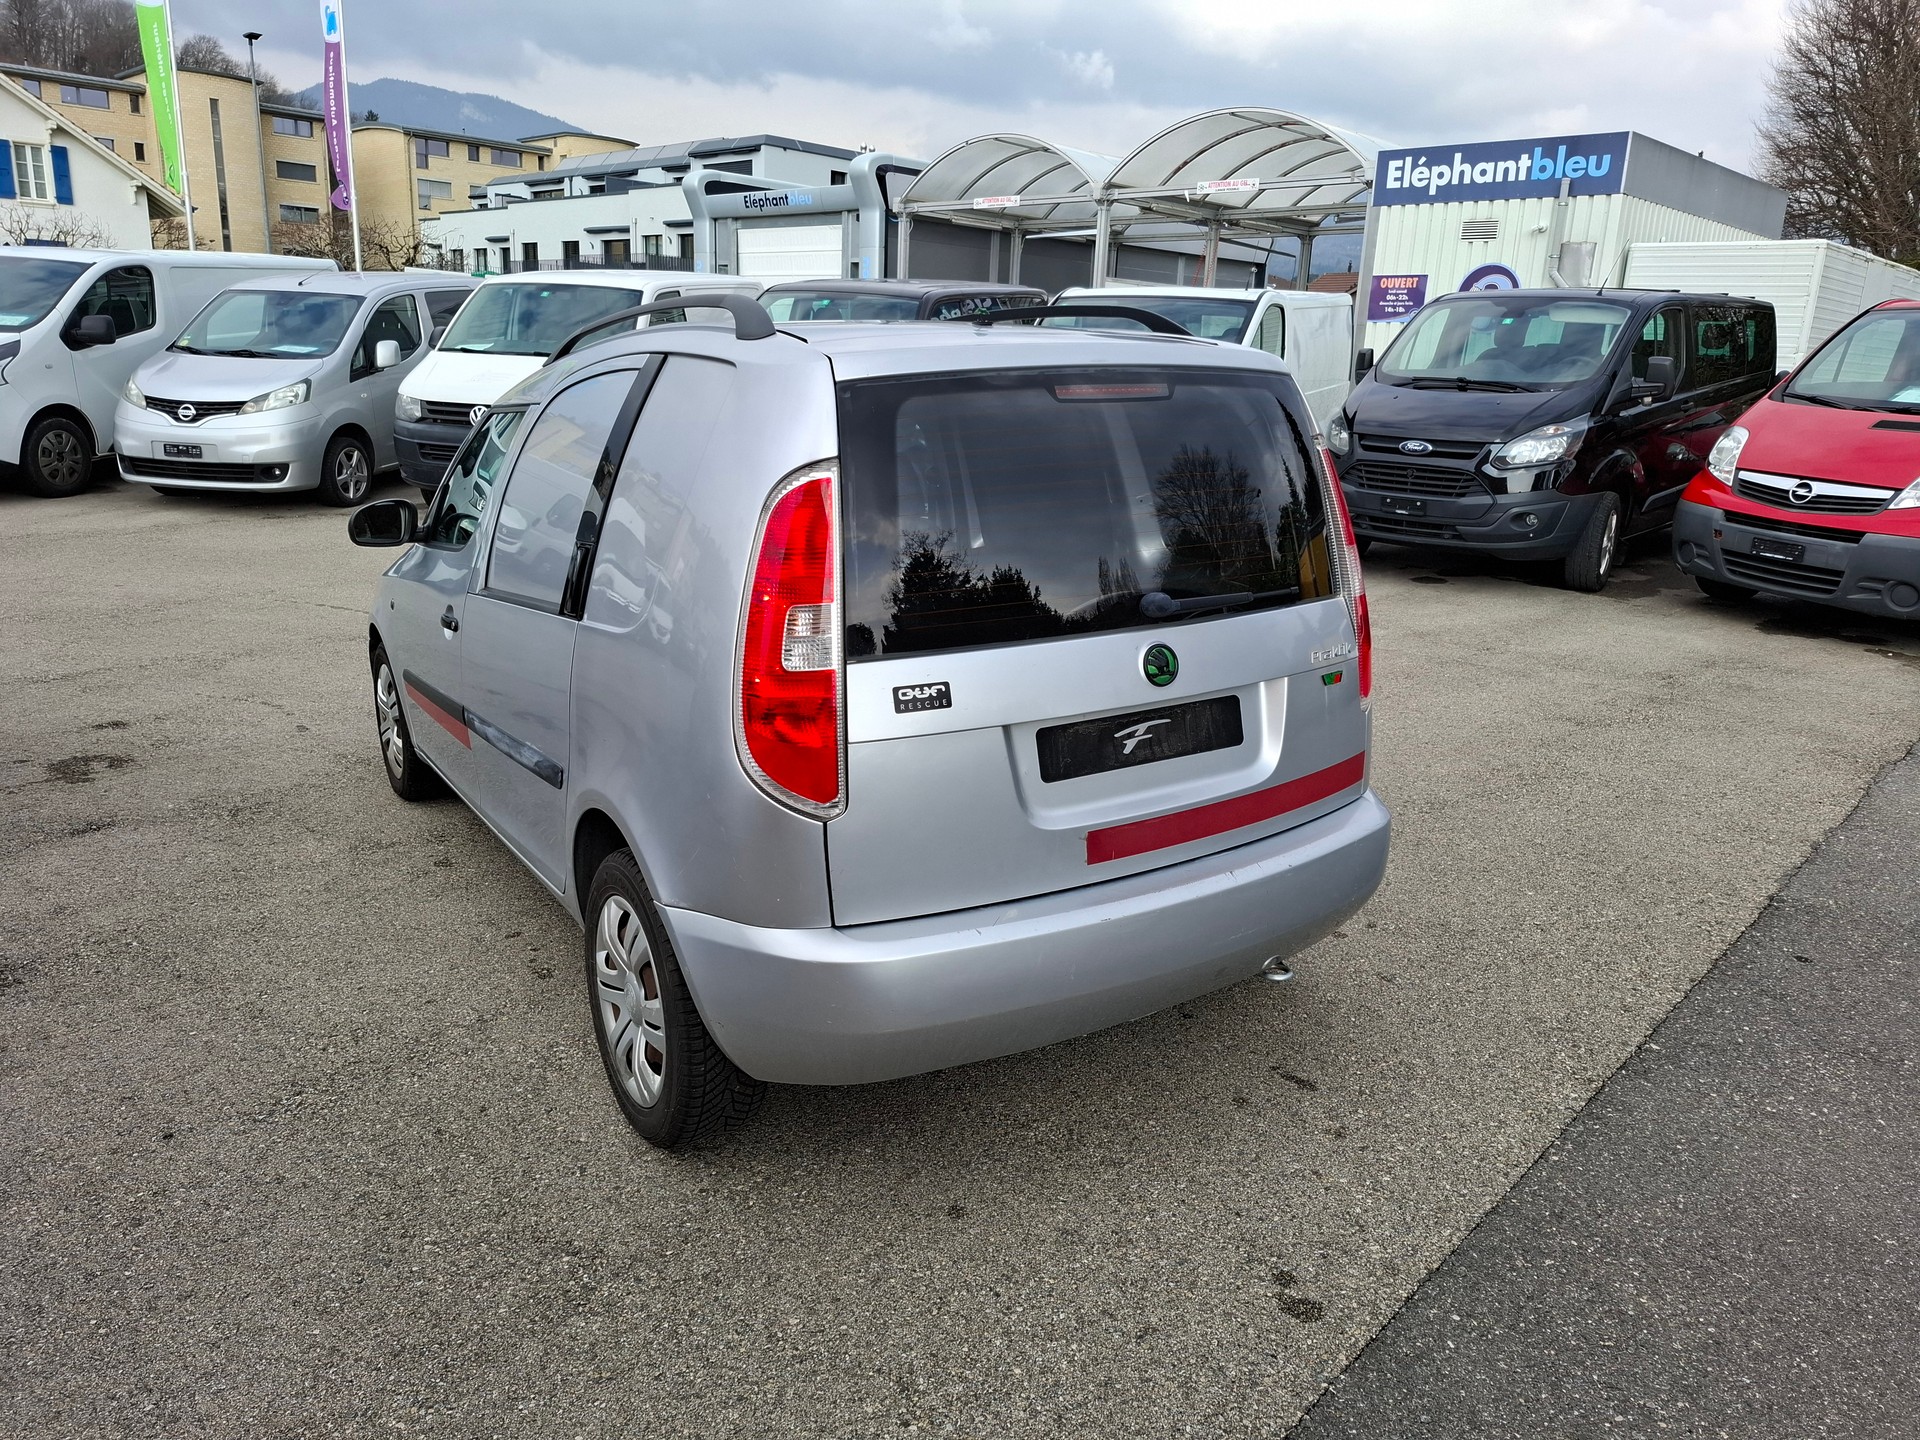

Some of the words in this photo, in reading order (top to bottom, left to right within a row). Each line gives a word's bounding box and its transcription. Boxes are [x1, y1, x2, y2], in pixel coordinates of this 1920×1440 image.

[1386, 145, 1611, 195] Eléphantbleu
[743, 191, 812, 212] Eléphantbleu
[1380, 277, 1419, 288] OUVERT
[900, 698, 948, 711] RESCUE
